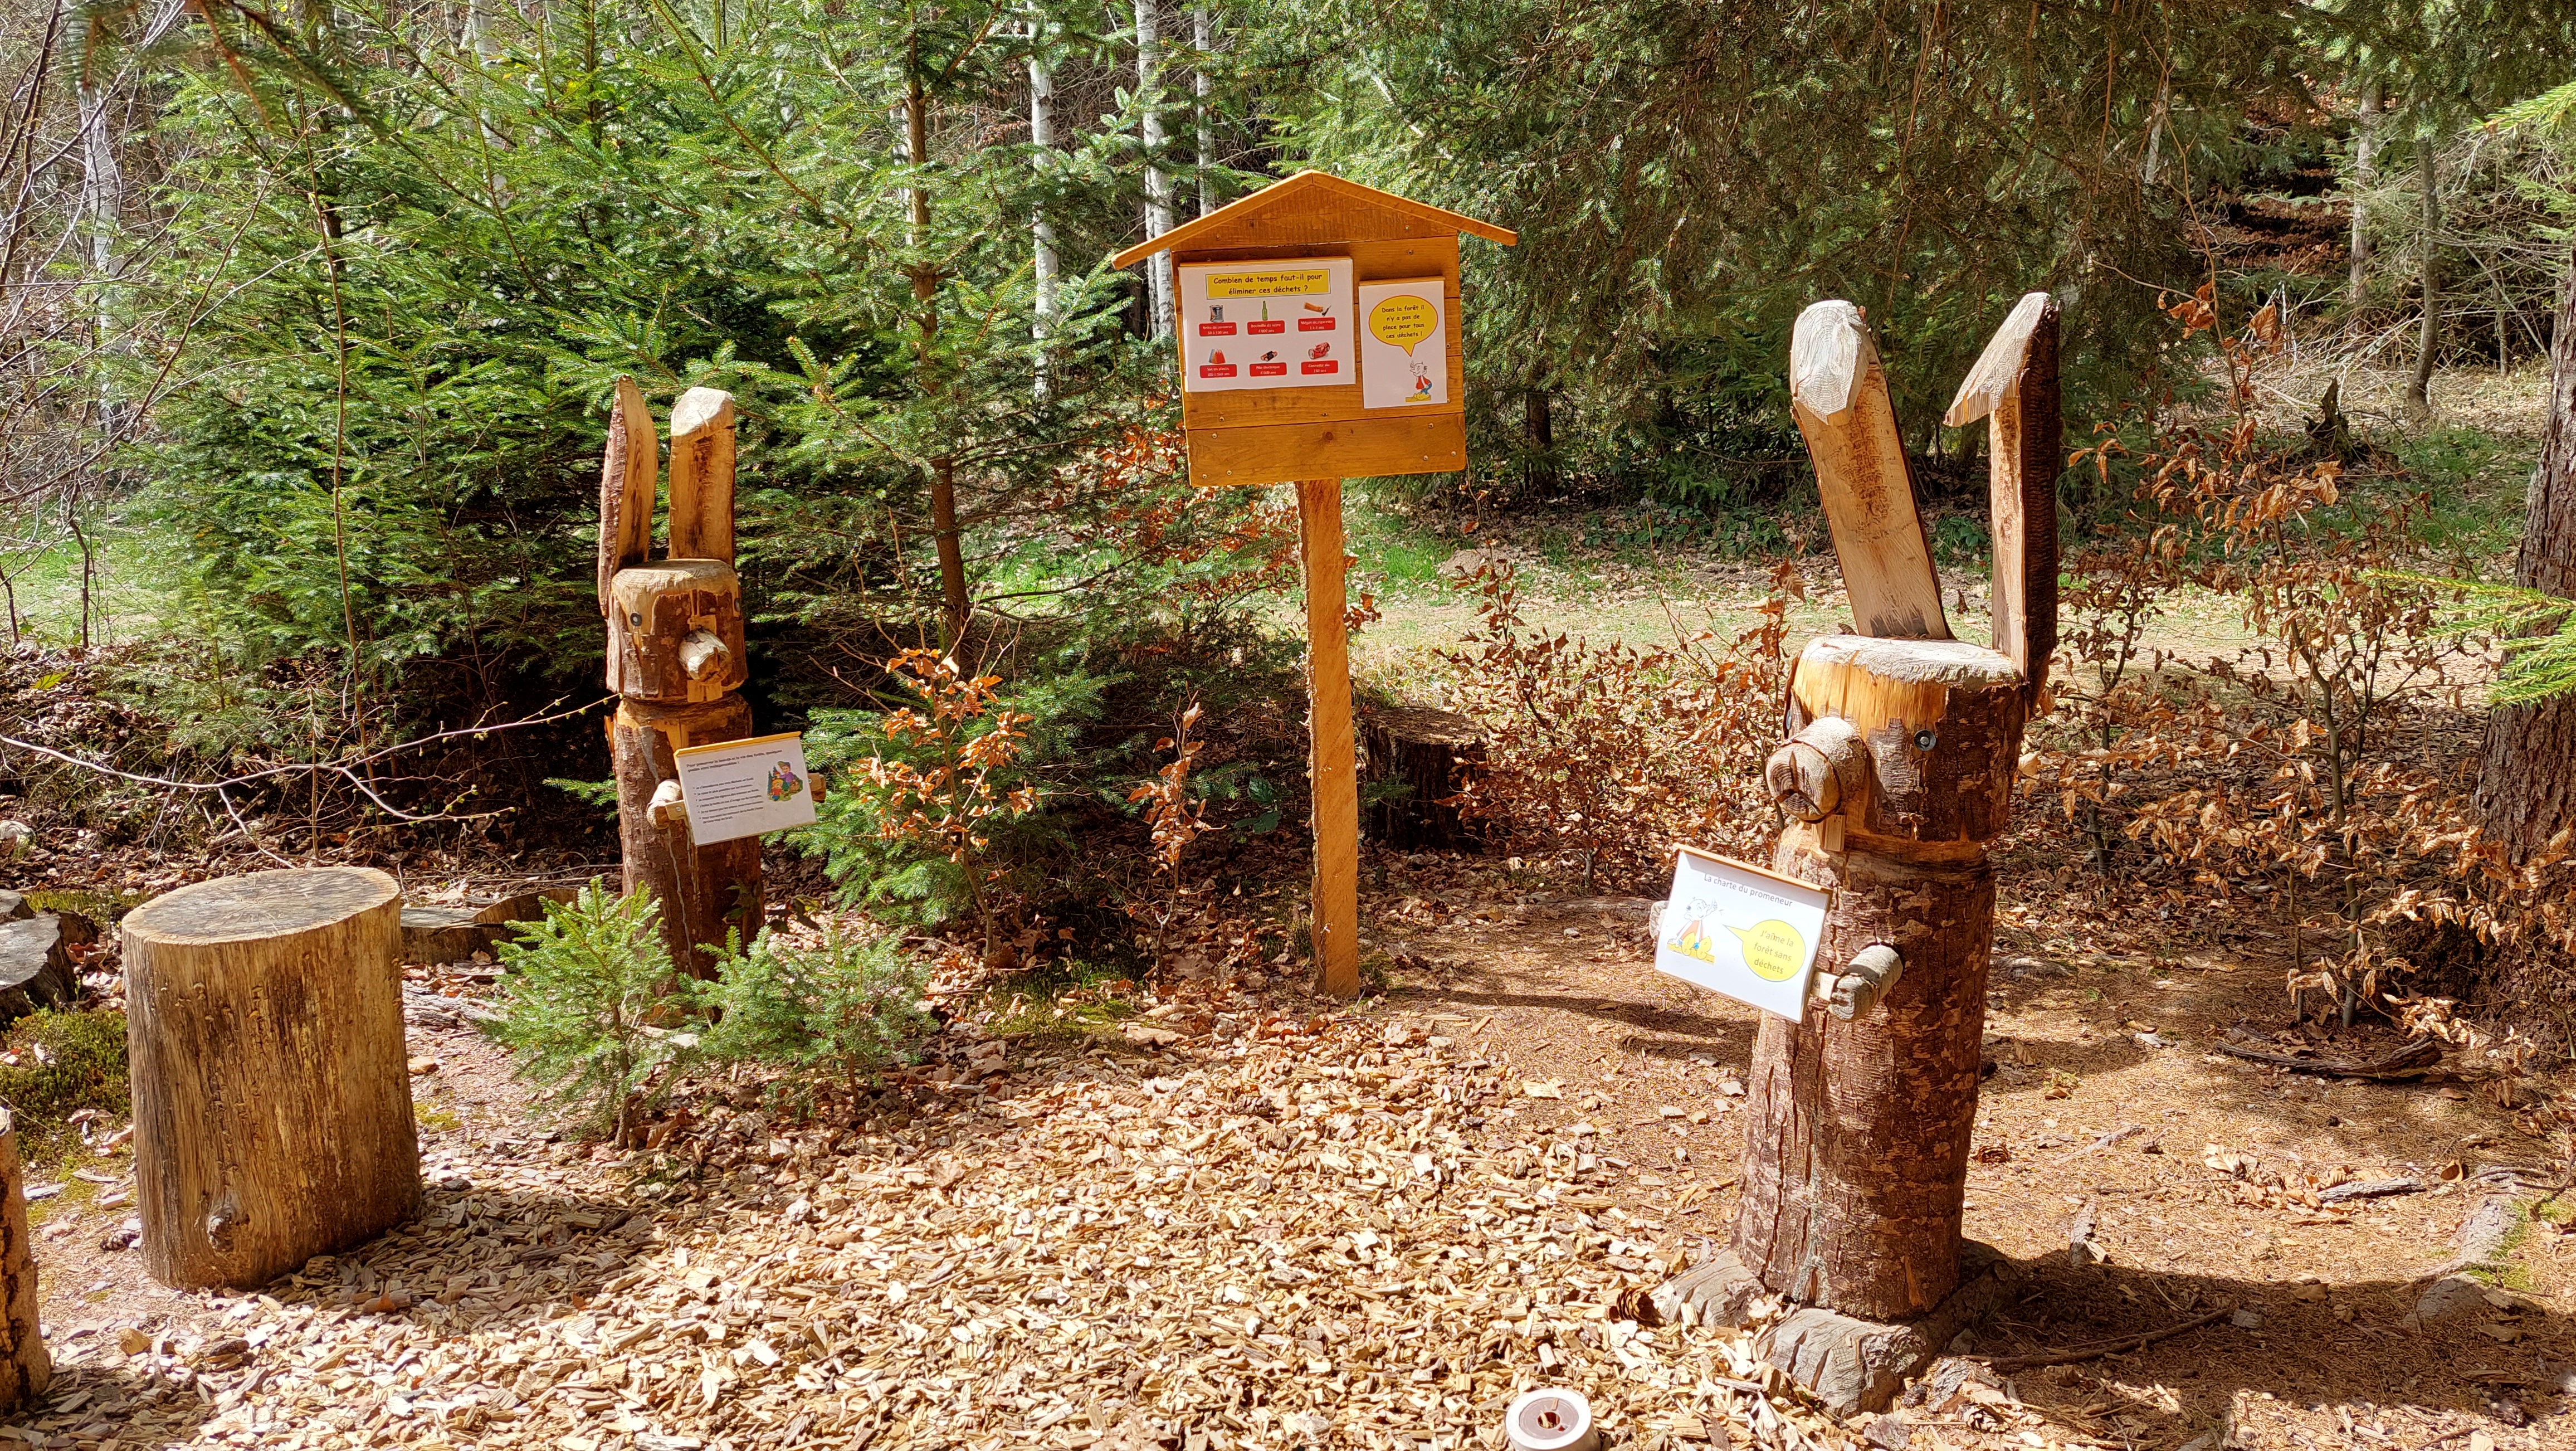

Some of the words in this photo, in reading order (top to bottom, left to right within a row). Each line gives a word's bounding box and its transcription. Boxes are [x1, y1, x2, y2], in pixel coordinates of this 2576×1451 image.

[1257, 275, 1277, 284] temps
[1704, 874, 1712, 882] La
[1714, 877, 1736, 890] charte
[1739, 884, 1748, 893] du
[1749, 889, 1793, 907] promeneur
[1787, 938, 1794, 947] la
[1754, 942, 1773, 955] forêt
[1774, 951, 1792, 961] sans
[1754, 958, 1783, 974] déchets
